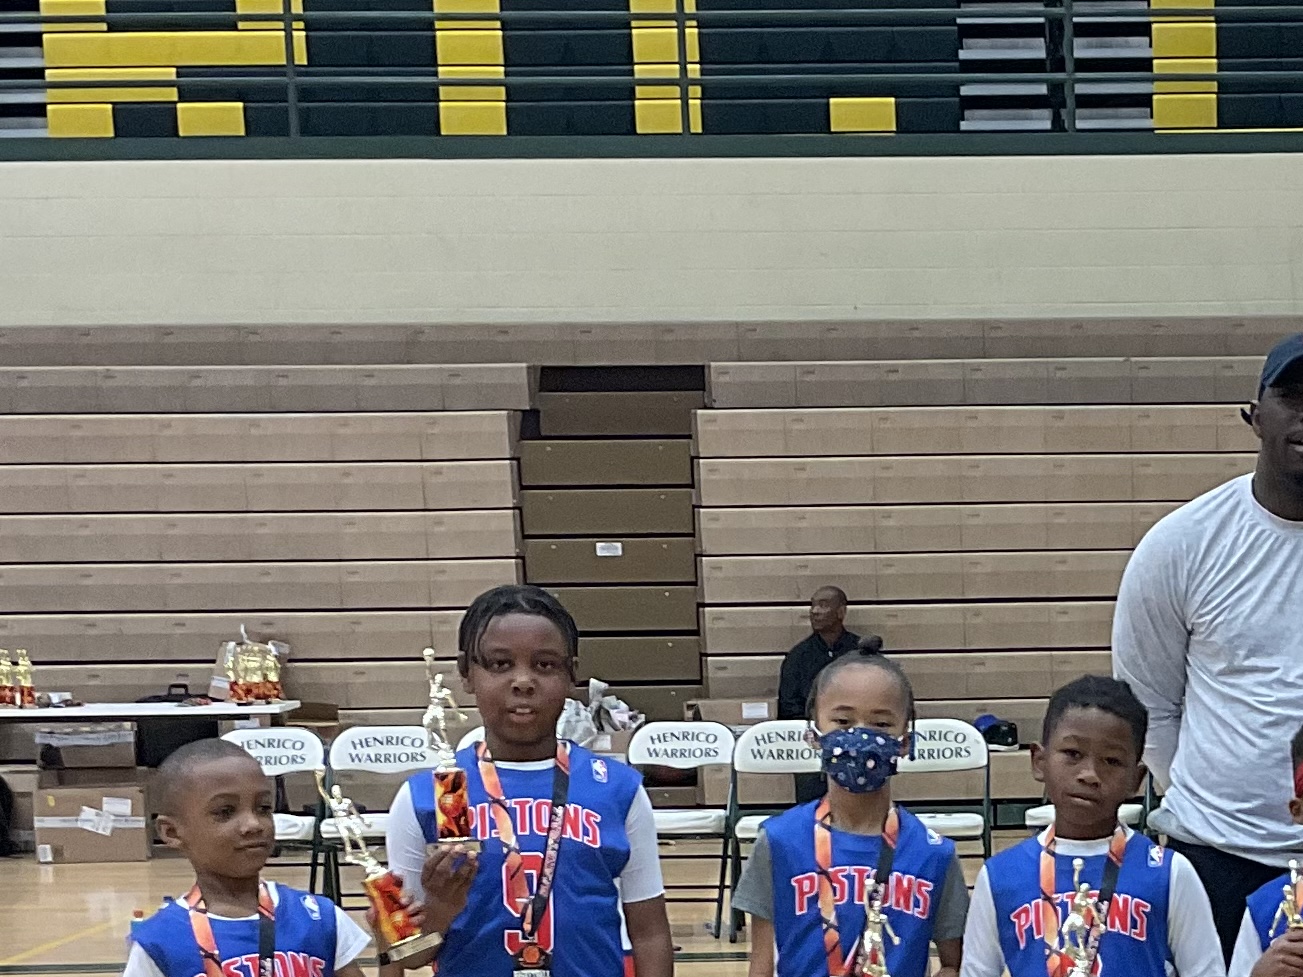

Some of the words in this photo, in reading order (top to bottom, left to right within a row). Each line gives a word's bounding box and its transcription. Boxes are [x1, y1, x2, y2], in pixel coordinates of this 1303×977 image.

[351, 735, 425, 750] HENRICO
[650, 731, 718, 745] HENRICO
[754, 730, 802, 746] HENRI
[915, 730, 966, 744] NRICO
[348, 751, 427, 764] WARRIORS
[646, 747, 719, 759] WARRIORS
[750, 748, 821, 761] WARRIOR
[917, 746, 971, 760] RRIORS
[791, 866, 933, 920] PSTNS
